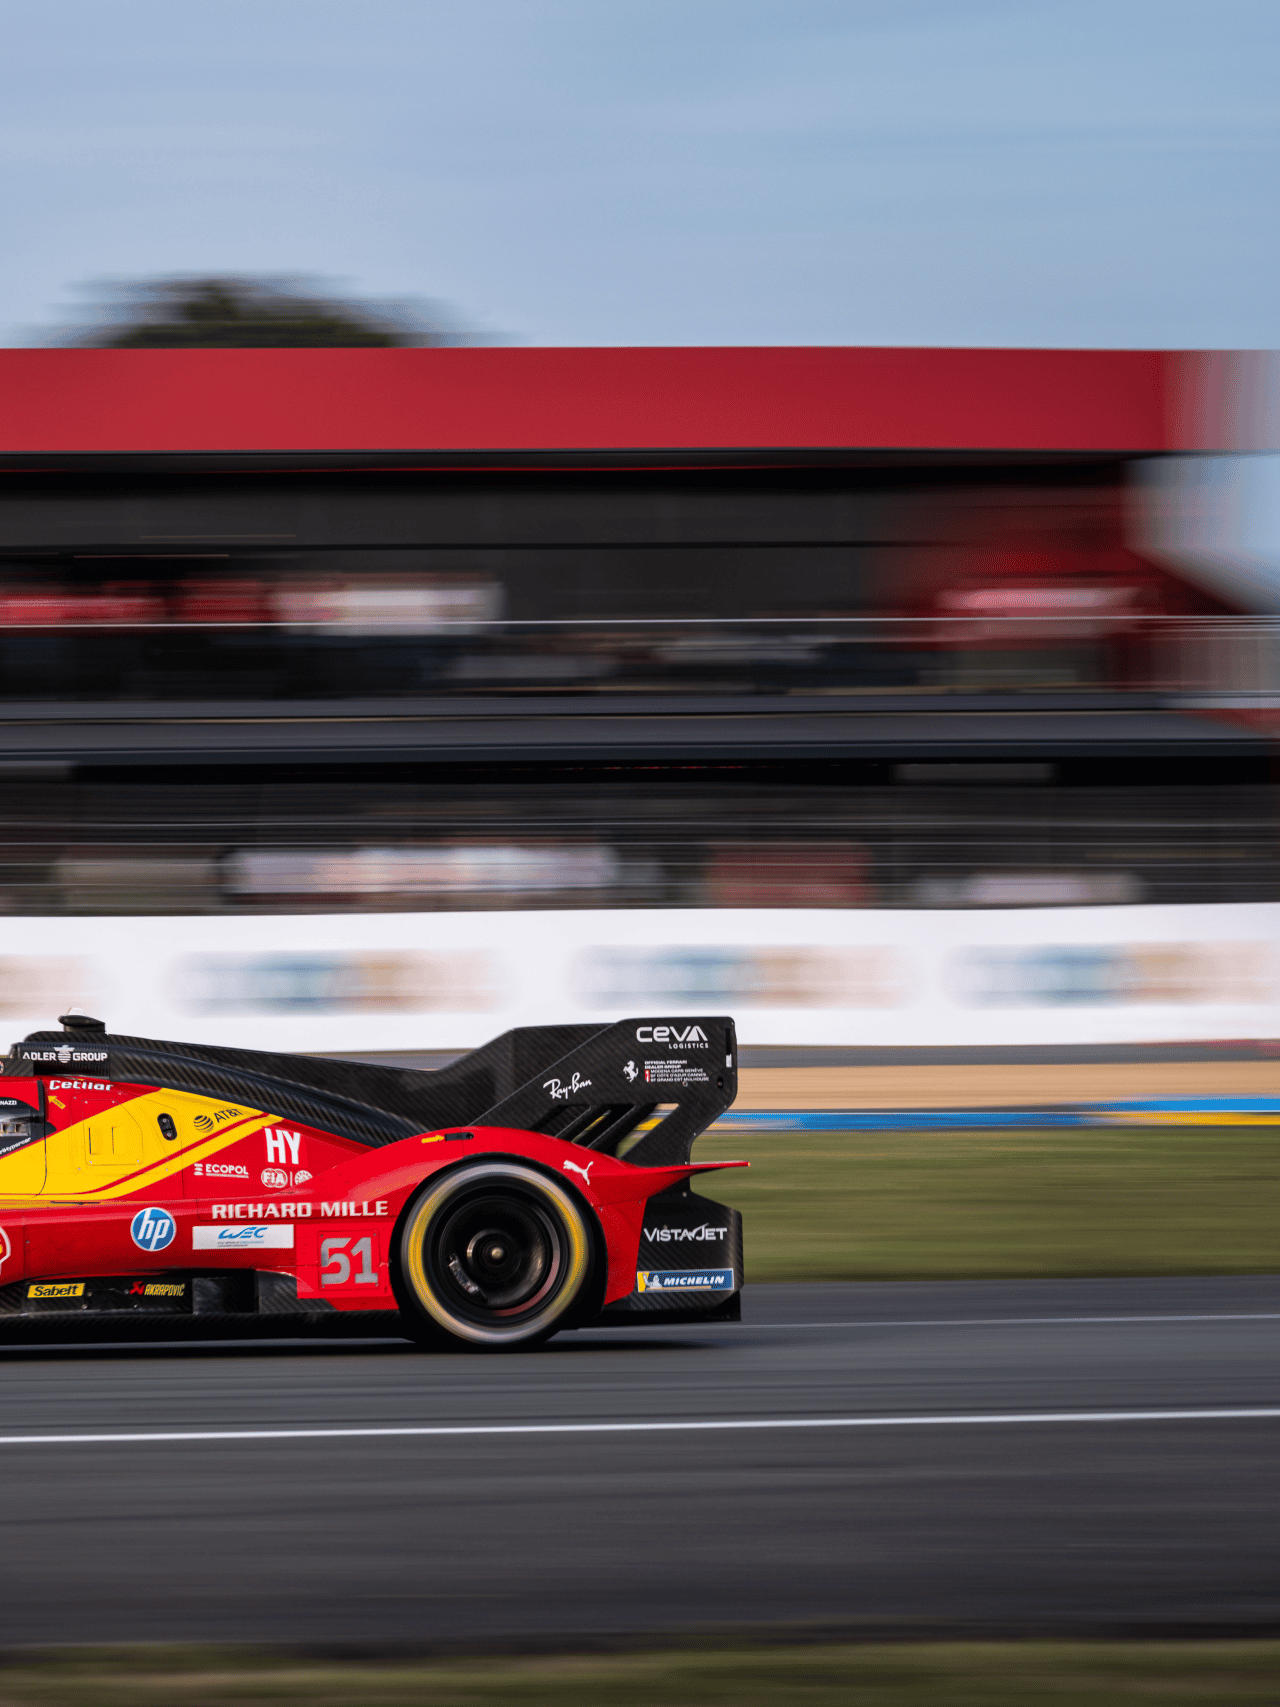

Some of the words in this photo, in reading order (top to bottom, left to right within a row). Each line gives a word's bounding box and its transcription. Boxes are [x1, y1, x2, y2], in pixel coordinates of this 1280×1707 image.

[636, 1026, 708, 1042] CEVA
[22, 1052, 56, 1061] ADLER
[72, 1053, 108, 1061] GROUP
[49, 1080, 114, 1091] Cetilar
[214, 1108, 243, 1123] AT&T
[264, 1127, 301, 1165] HY
[205, 1163, 248, 1175] ECOPOL
[264, 1172, 285, 1184] FIA
[212, 1203, 312, 1219] RICHARD
[321, 1201, 389, 1217] MILLE
[137, 1208, 171, 1251] hp
[218, 1226, 268, 1239] WEC
[320, 1237, 379, 1285] 51
[663, 1276, 725, 1286] MICHELIN
[34, 1285, 78, 1297] Sabelt
